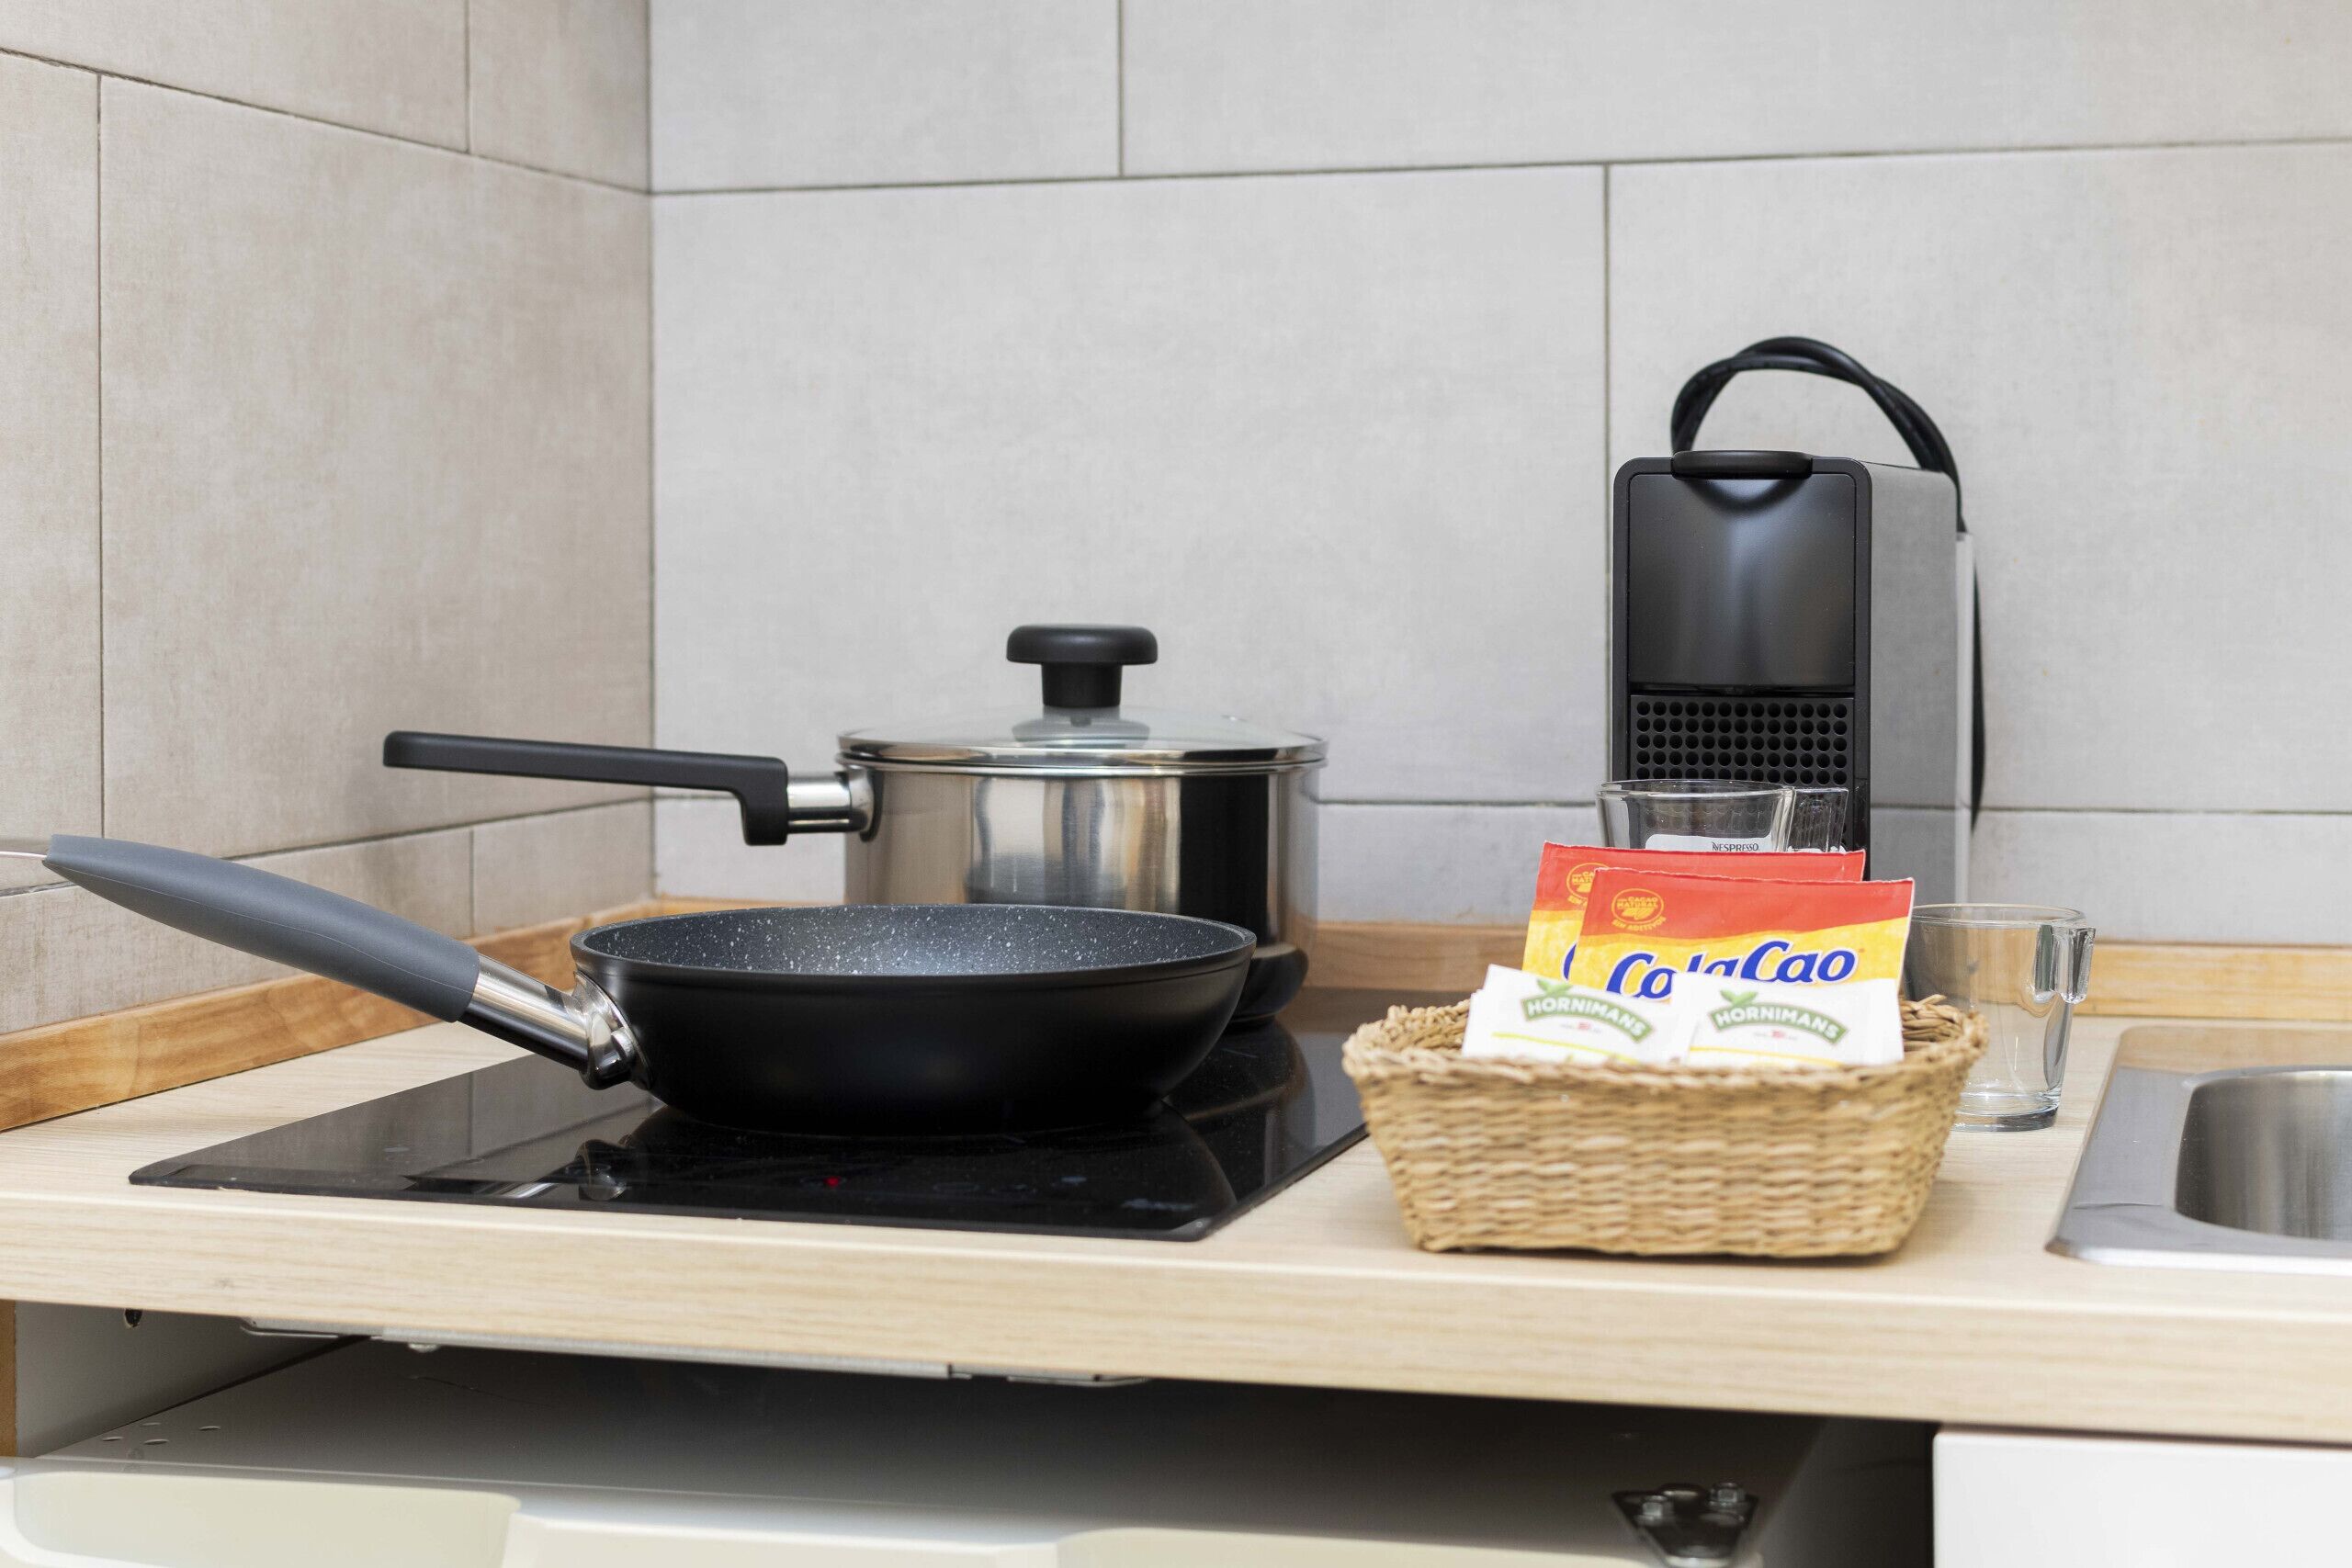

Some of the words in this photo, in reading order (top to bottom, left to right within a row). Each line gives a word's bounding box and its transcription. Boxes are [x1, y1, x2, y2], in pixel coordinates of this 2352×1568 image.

[1712, 841, 1759, 852] NESPRESSO
[1527, 996, 1646, 1037] HORNIMANS
[1714, 1006, 1839, 1040] HORNIMANS
